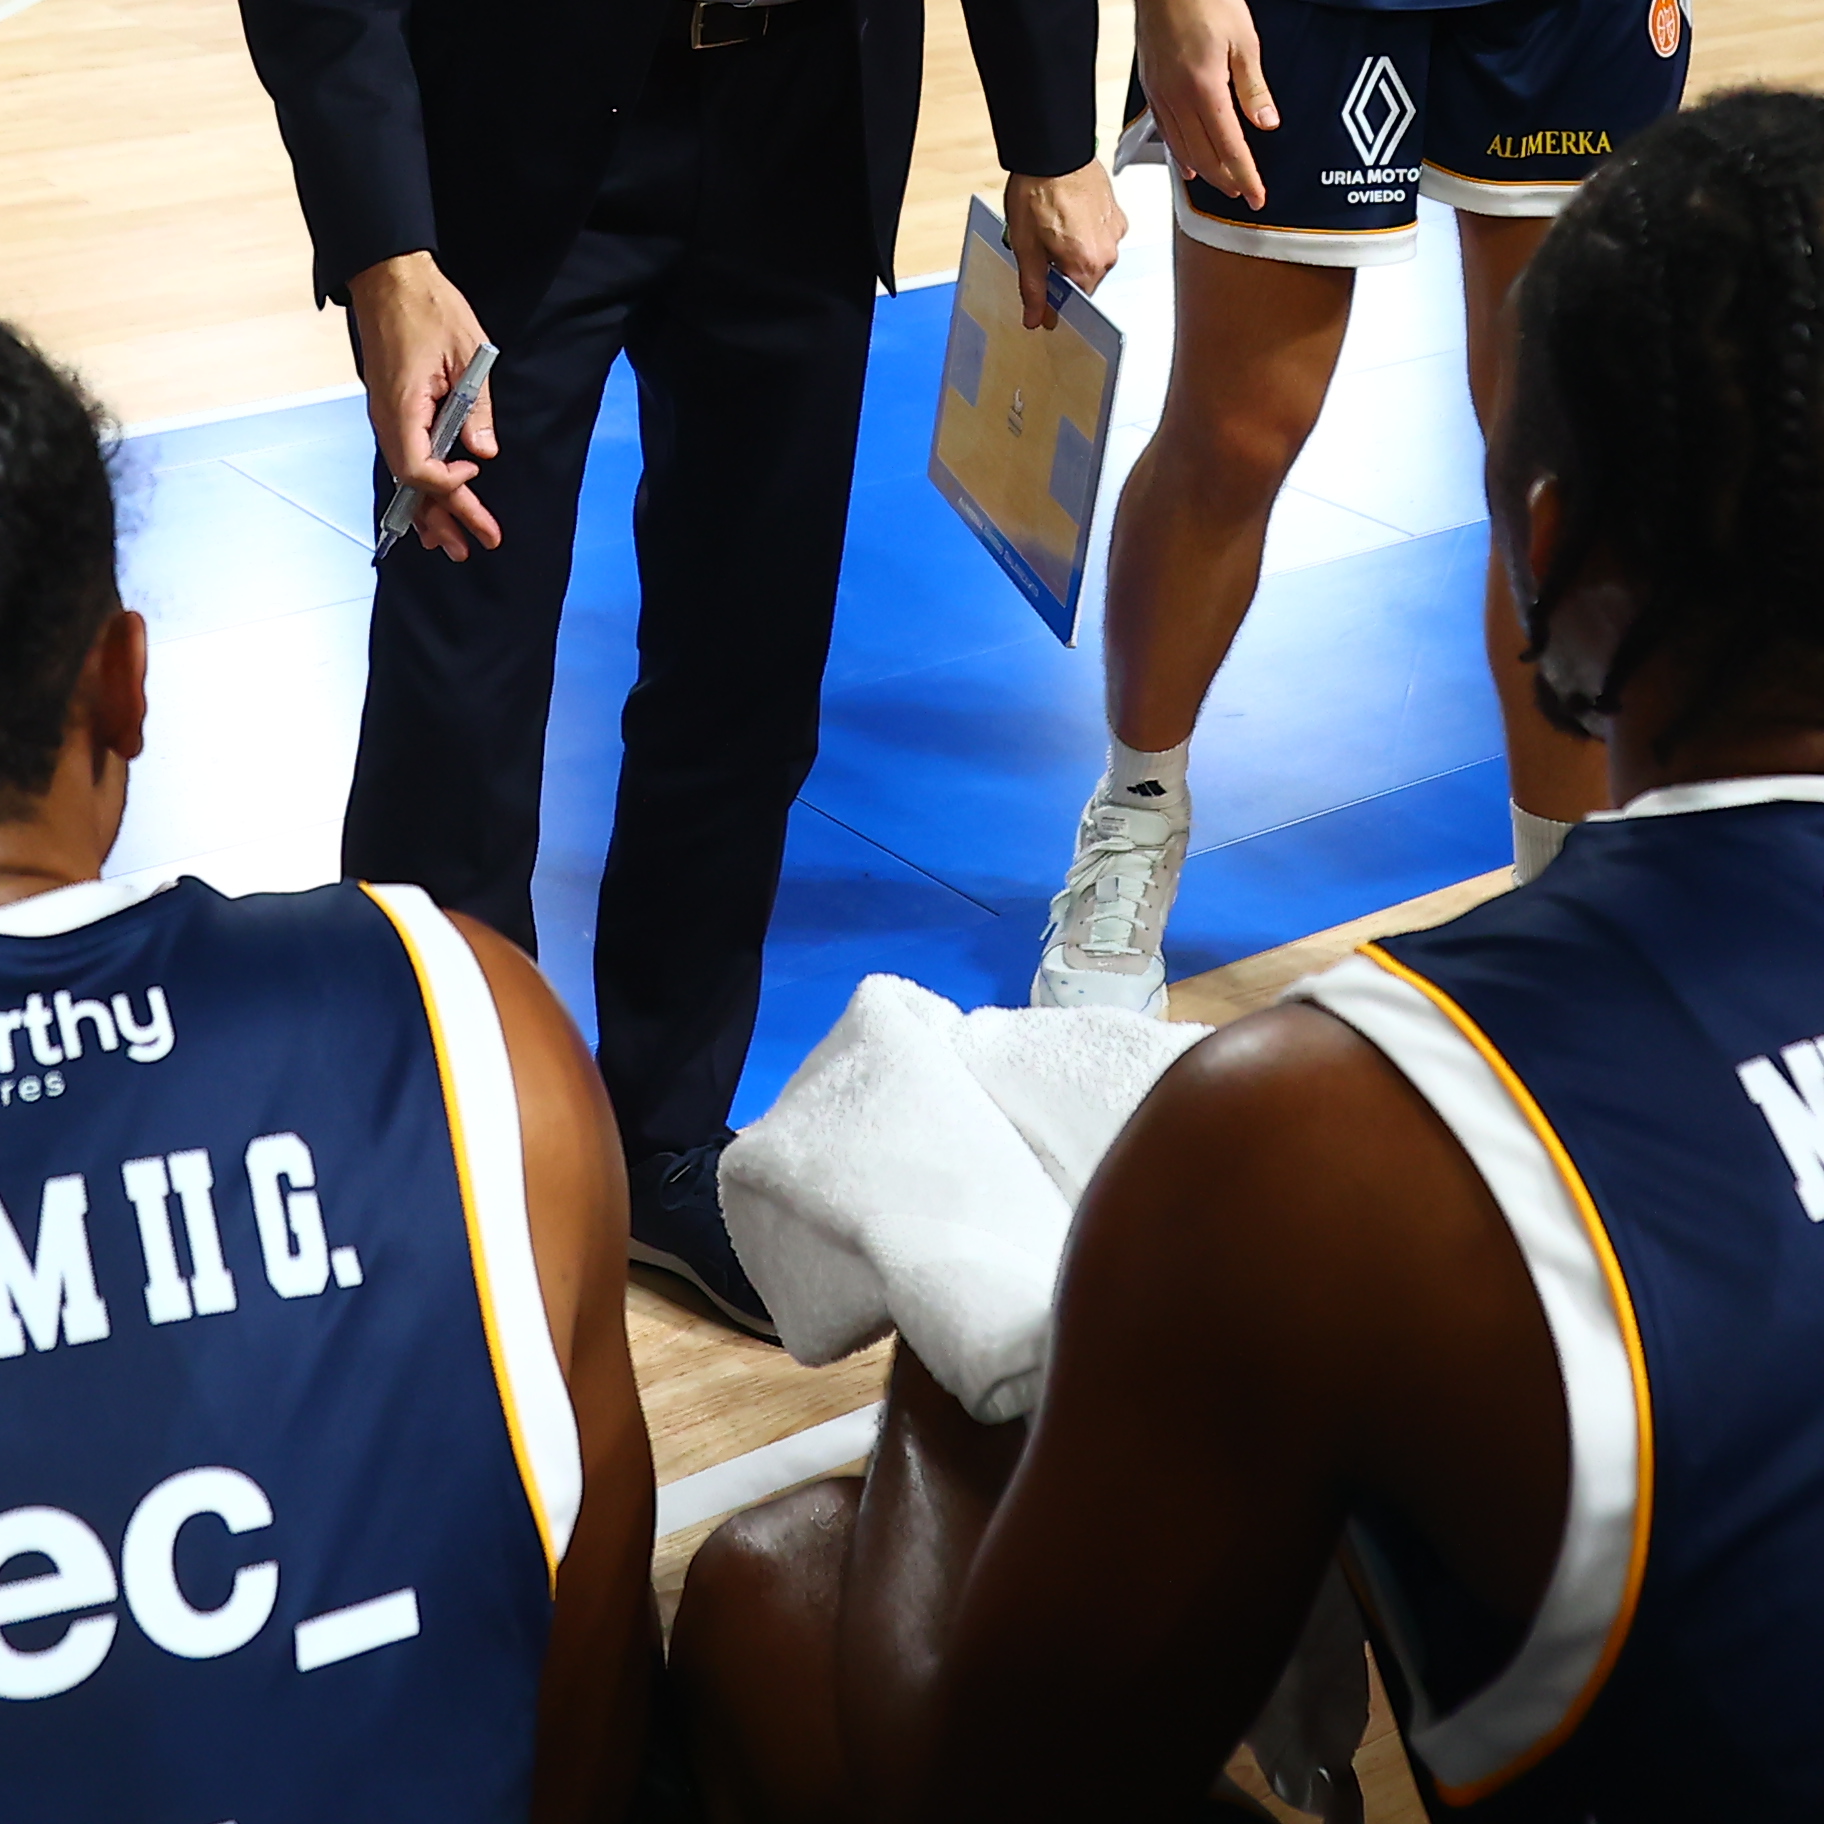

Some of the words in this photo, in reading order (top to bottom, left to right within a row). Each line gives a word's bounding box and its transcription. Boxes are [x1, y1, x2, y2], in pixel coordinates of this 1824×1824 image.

[1486, 129, 1613, 159] ALIMERKA
[1320, 169, 1366, 186] URIA
[1367, 166, 1422, 184] MOTO
[1346, 188, 1407, 205] OVIEDO
[121, 1146, 238, 1328] II
[243, 1130, 366, 1302] G.
